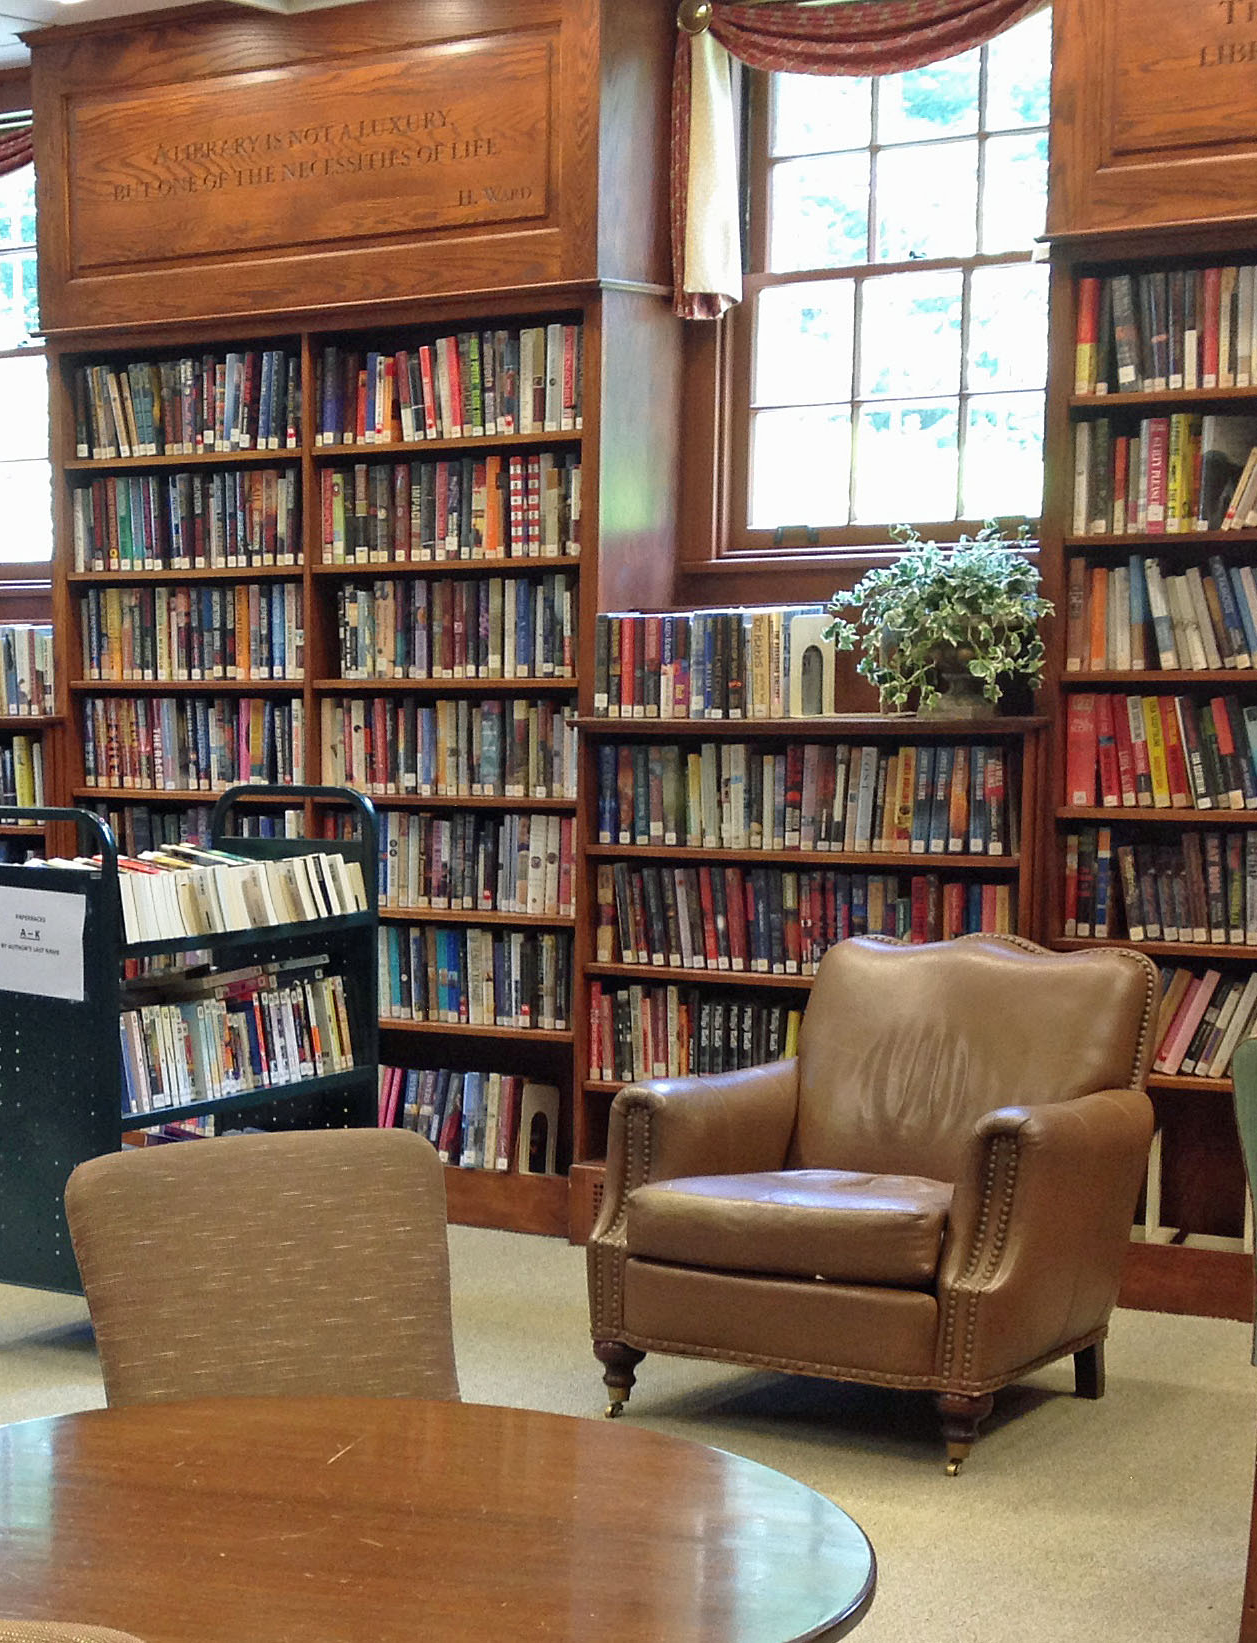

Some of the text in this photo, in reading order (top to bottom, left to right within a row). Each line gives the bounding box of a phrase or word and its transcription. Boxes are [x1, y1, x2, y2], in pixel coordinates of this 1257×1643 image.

[174, 134, 261, 162] LIBRARY
[265, 132, 282, 151] IS
[288, 124, 334, 149] NOT
[114, 137, 500, 201] BUT ONE OF THE NECESSITIES OF LIFE
[412, 484, 421, 523] IMPACT
[153, 728, 163, 780] THE RACE
[198, 726, 207, 768] PATTERSON
[862, 752, 872, 791] COST
[987, 759, 995, 788] ROLLINS
[45, 948, 60, 956] NAME
[701, 1005, 710, 1046] Philip Roth
[713, 1006, 722, 1047] Philip Roth
[729, 1006, 738, 1048] Philip Roth
[742, 1008, 752, 1050] Philip Roth
[769, 1009, 779, 1051] Philip Roth
